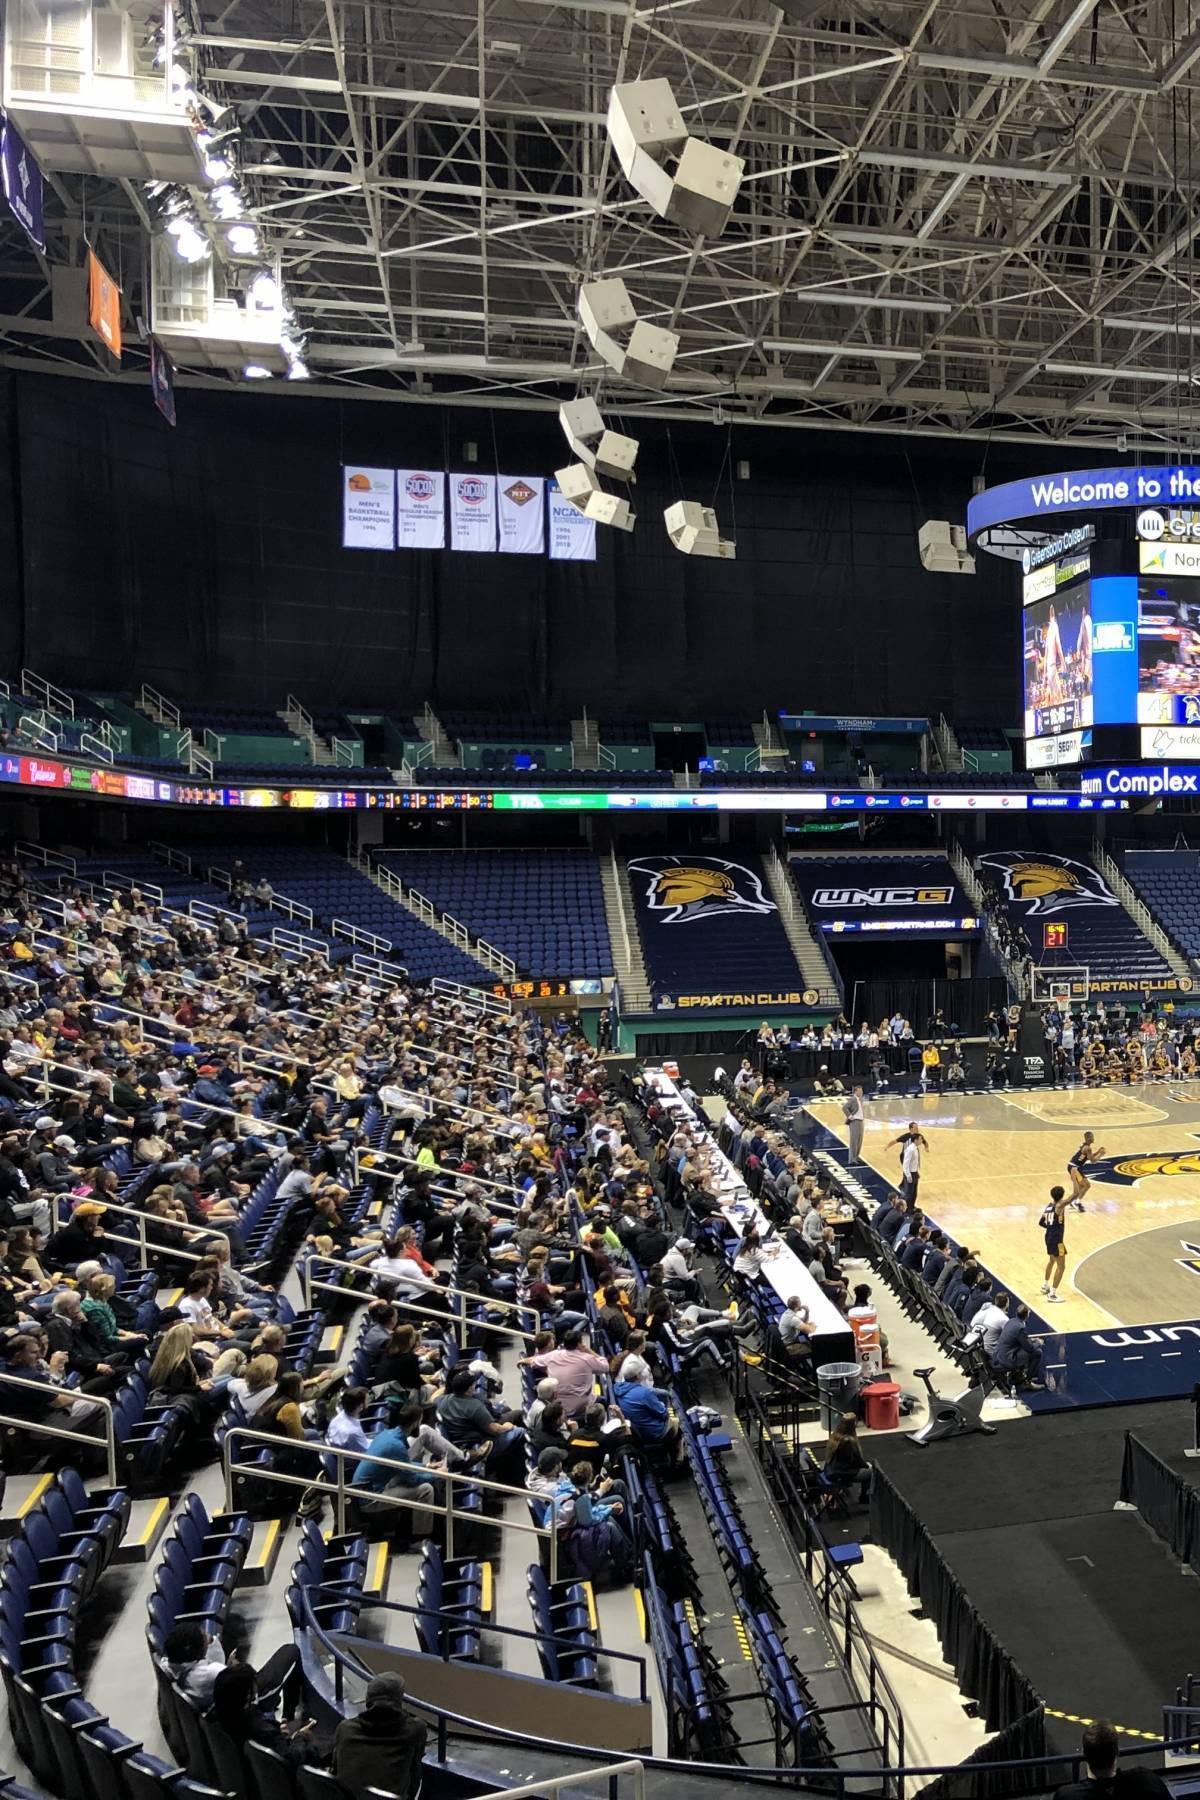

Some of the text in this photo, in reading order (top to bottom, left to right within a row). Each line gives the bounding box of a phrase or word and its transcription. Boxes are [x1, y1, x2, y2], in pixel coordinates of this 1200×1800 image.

[405, 479, 436, 496] SOCON
[458, 482, 487, 498] SOCON
[1031, 478, 1129, 507] Welcome
[1137, 476, 1161, 497] to
[837, 719, 873, 727] WYNDHAM
[1106, 767, 1198, 796] Complex
[815, 888, 951, 906] UNCG
[1073, 980, 1177, 992] SPARTAN CLUB
[677, 993, 801, 1008] SPARTAN CLUB
[1023, 1056, 1045, 1065] TFA
